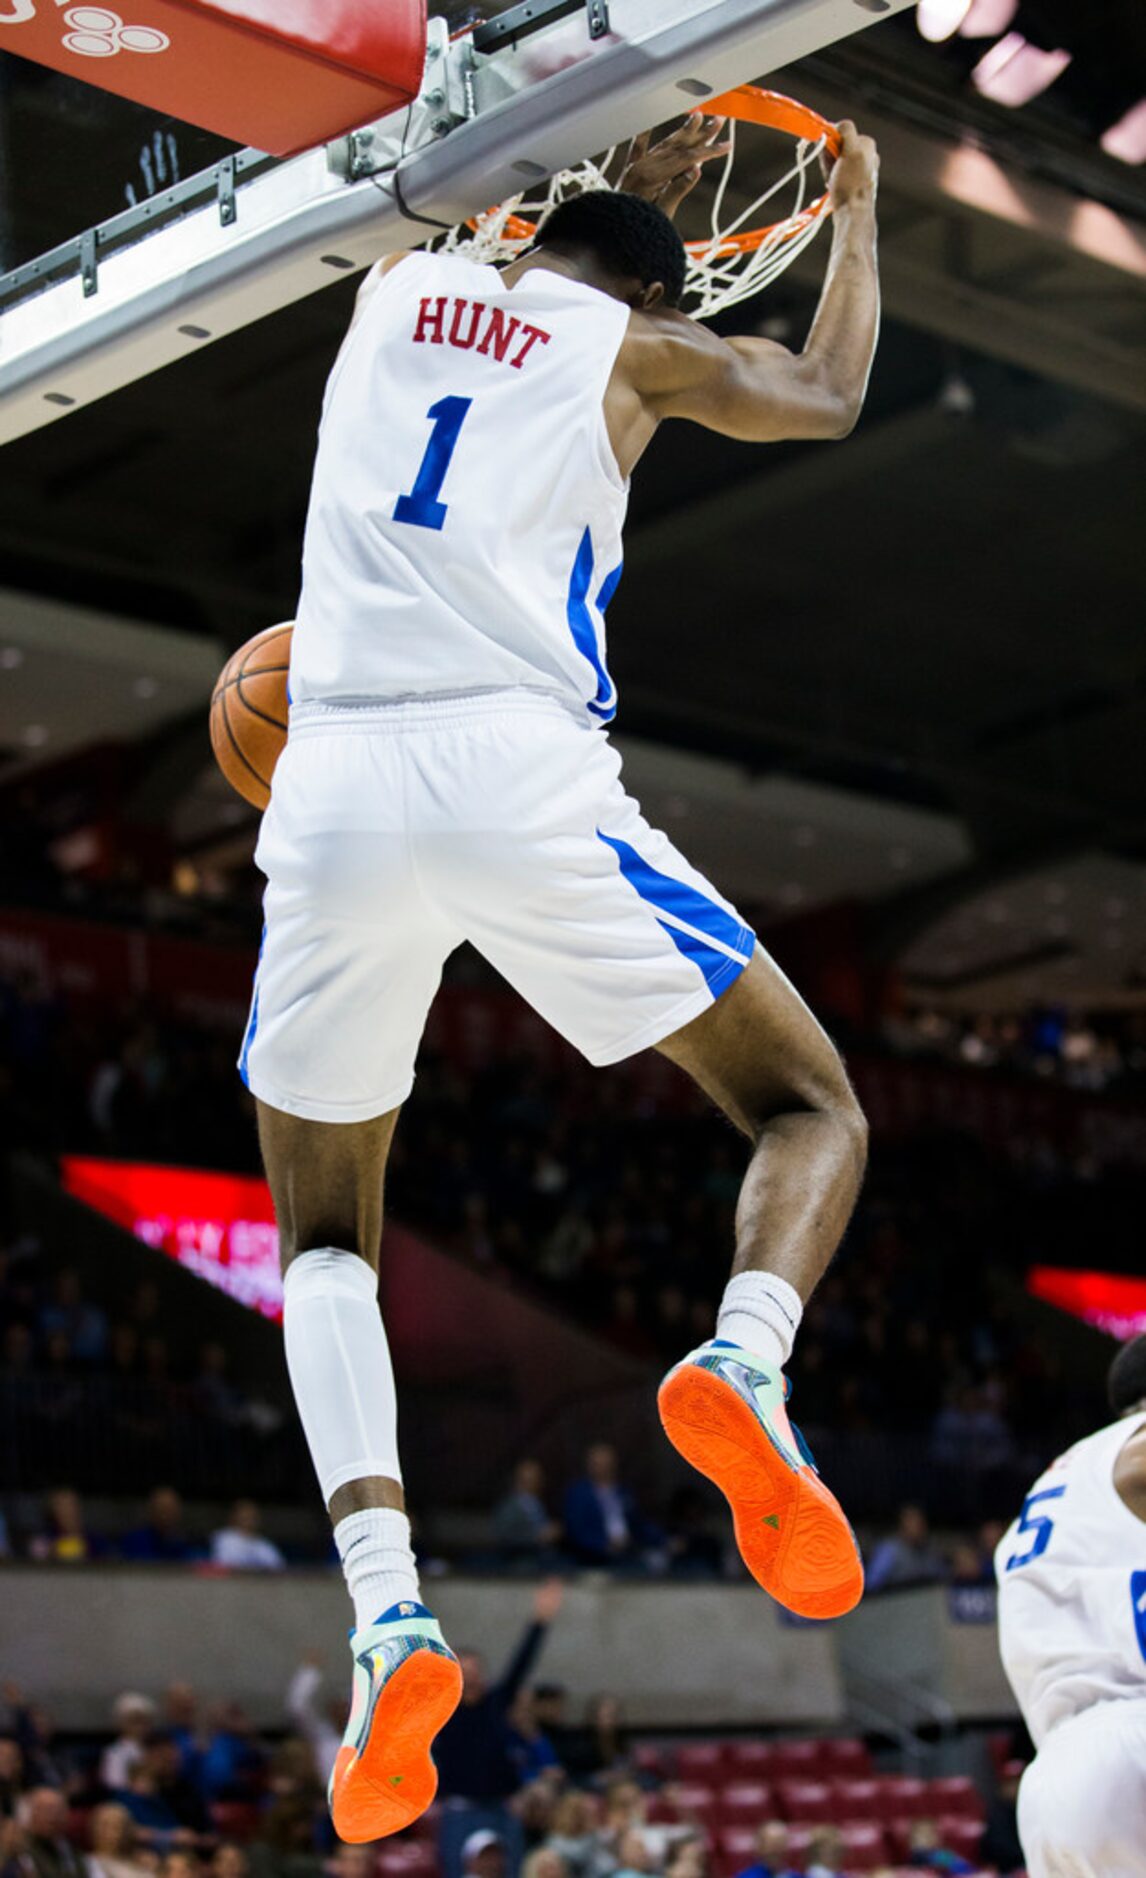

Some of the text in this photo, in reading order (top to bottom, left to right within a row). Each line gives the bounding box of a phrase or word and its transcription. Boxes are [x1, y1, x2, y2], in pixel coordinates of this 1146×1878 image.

[413, 297, 551, 369] HUNT
[392, 395, 473, 531] 1
[1005, 1484, 1067, 1572] 5
